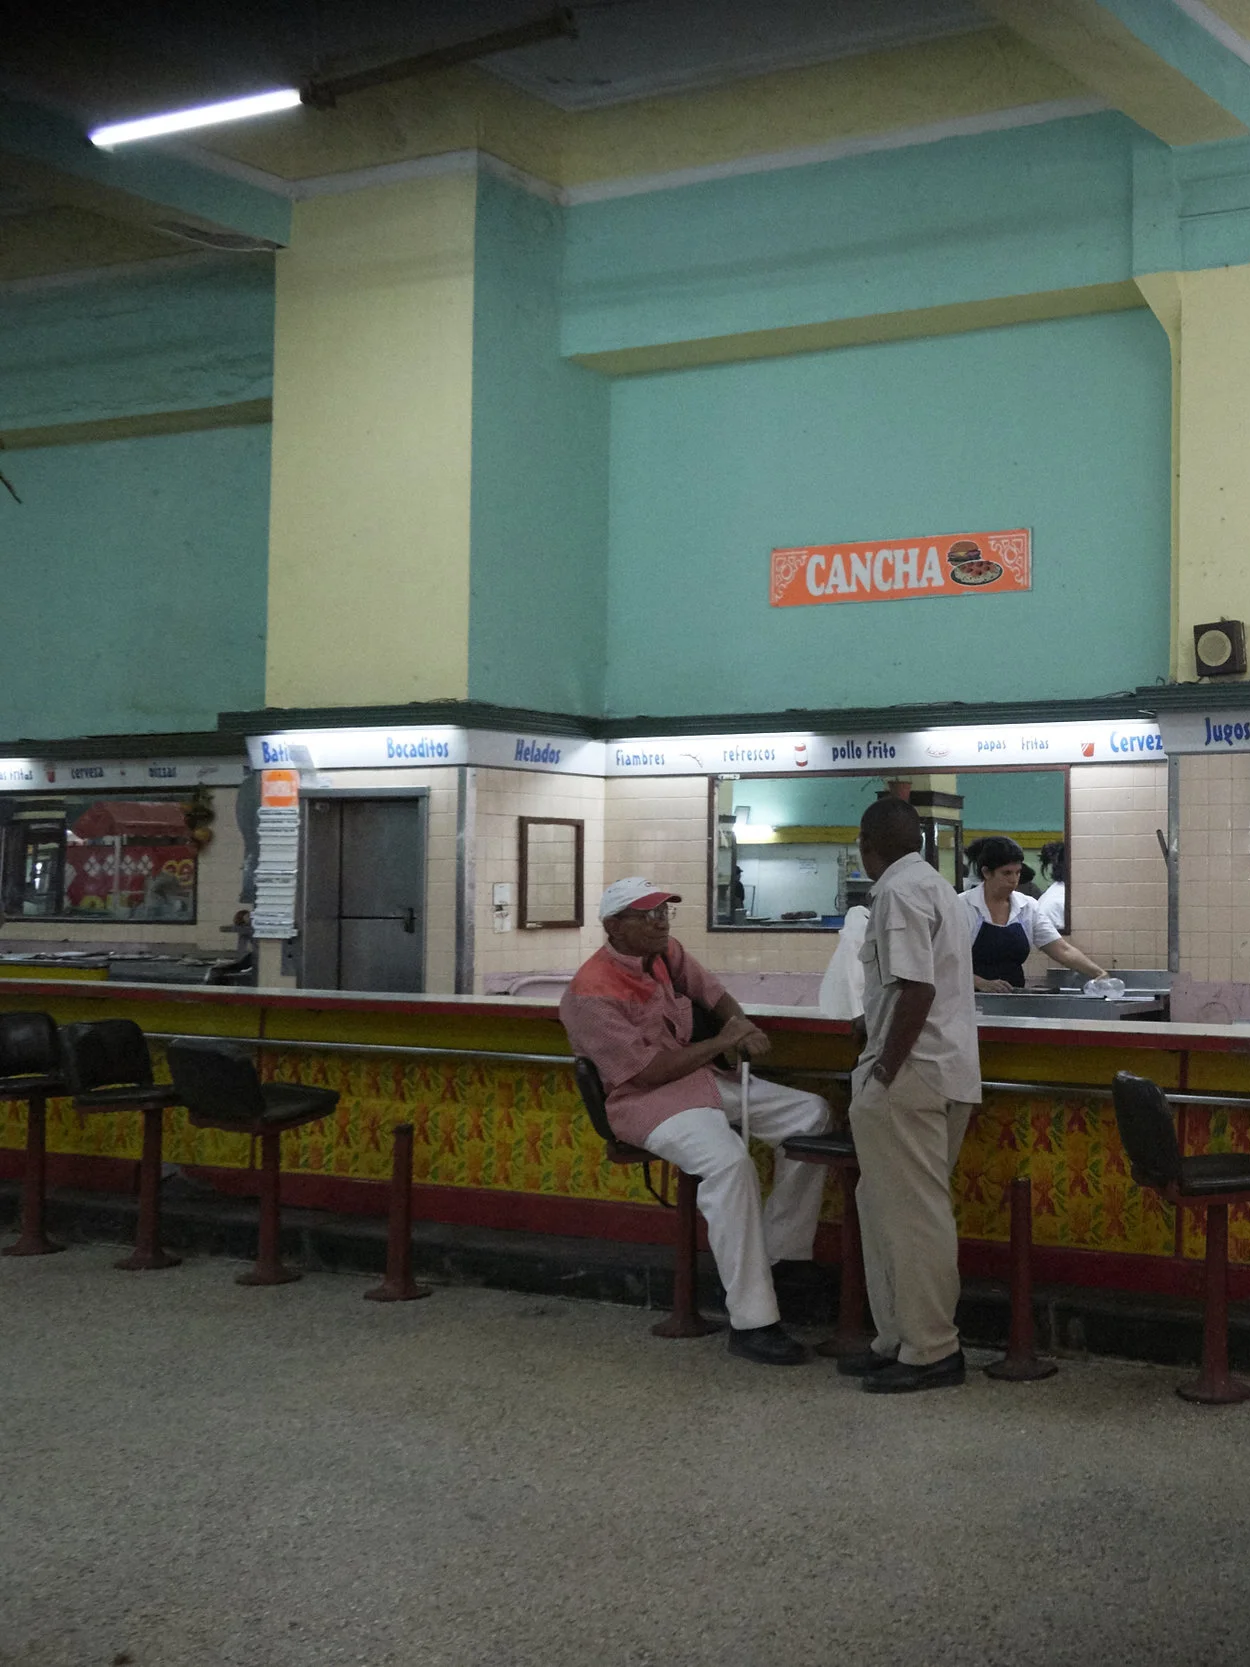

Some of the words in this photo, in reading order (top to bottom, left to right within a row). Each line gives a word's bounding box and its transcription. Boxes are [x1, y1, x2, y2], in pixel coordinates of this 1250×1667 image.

[806, 546, 944, 596] CANCHA
[1110, 731, 1163, 753] Cervez
[1204, 717, 1250, 746] Jugos
[261, 741, 289, 764] Bati
[386, 737, 449, 759] Bocaditos
[514, 738, 561, 764] Helados
[723, 745, 775, 762] refrescos
[832, 740, 862, 761] pollo
[867, 740, 896, 759] frito
[977, 740, 1006, 752] papas
[1021, 736, 1049, 750] fritas
